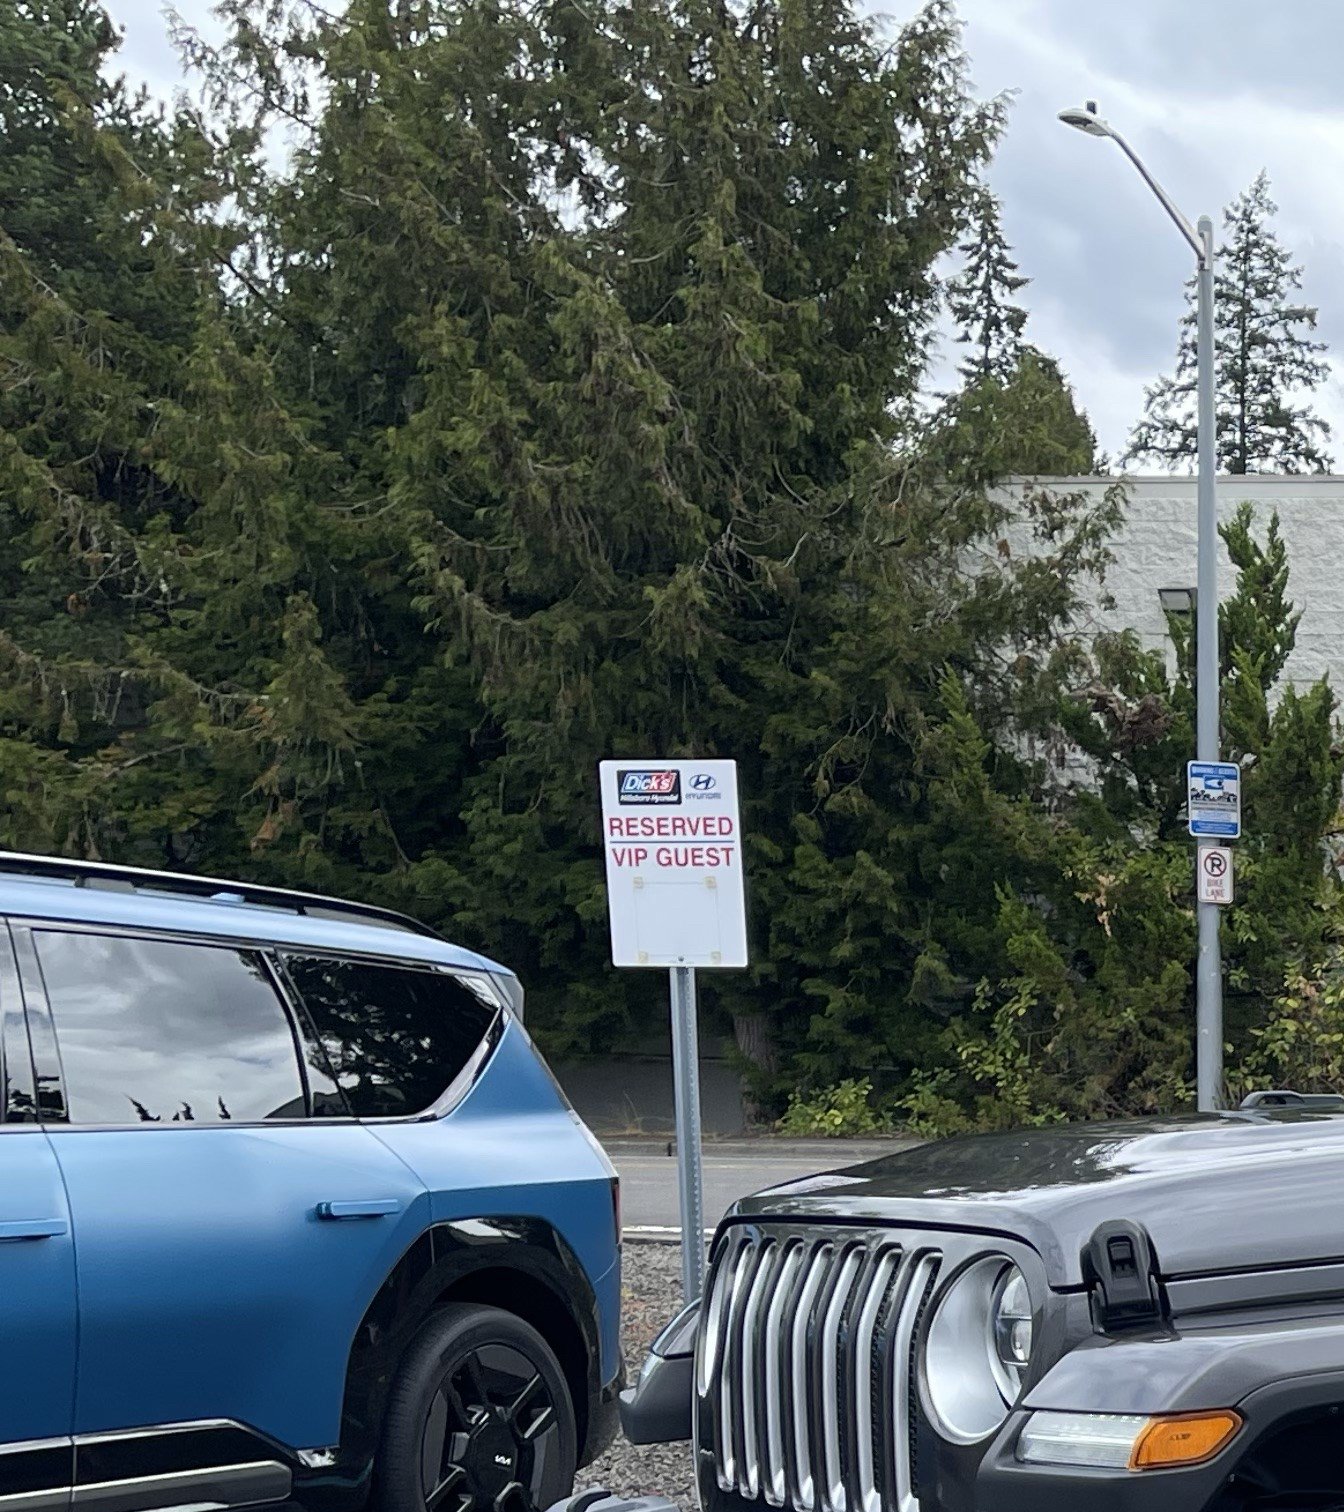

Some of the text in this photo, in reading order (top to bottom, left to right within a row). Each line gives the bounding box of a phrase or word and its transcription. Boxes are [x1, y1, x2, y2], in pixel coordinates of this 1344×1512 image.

[610, 817, 733, 836] RESERVED
[612, 848, 734, 866] VIP GUEST
